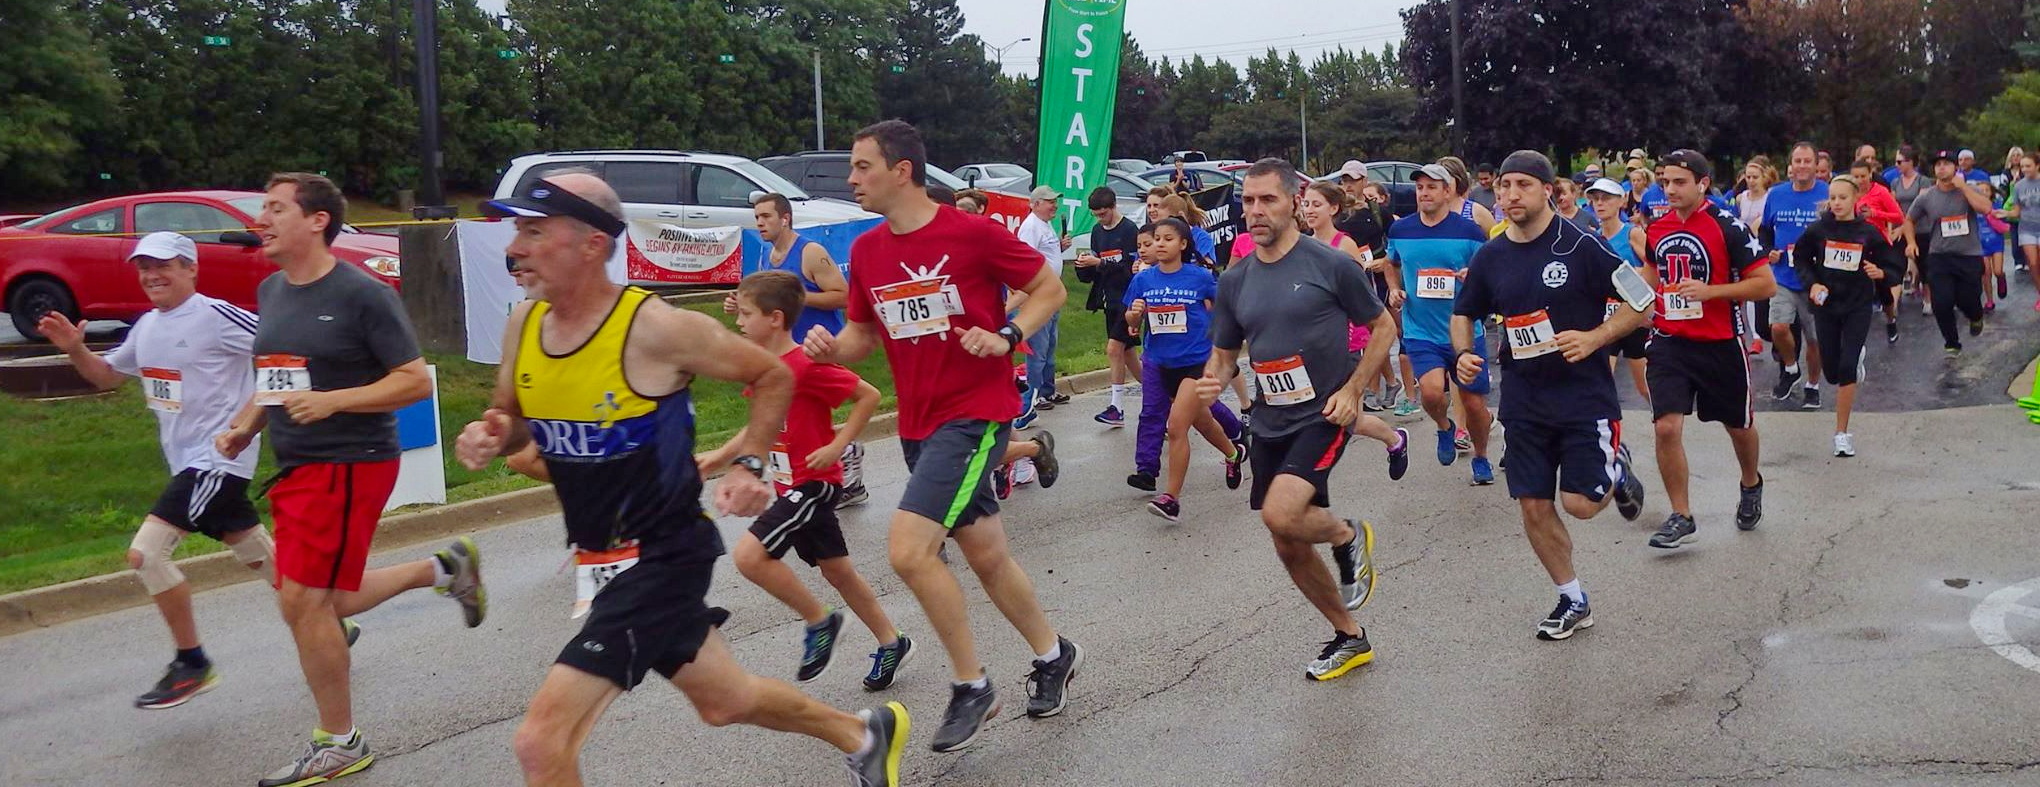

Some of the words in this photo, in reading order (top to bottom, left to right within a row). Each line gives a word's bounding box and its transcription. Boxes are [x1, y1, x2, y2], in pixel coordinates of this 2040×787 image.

[1062, 23, 1094, 232] START
[645, 239, 671, 253] BEGINS
[1833, 250, 1852, 263] 795
[1426, 276, 1446, 290] 896
[898, 297, 930, 322] 785
[1157, 313, 1176, 326] 977
[1514, 326, 1541, 347] 901
[1266, 372, 1296, 394] 810
